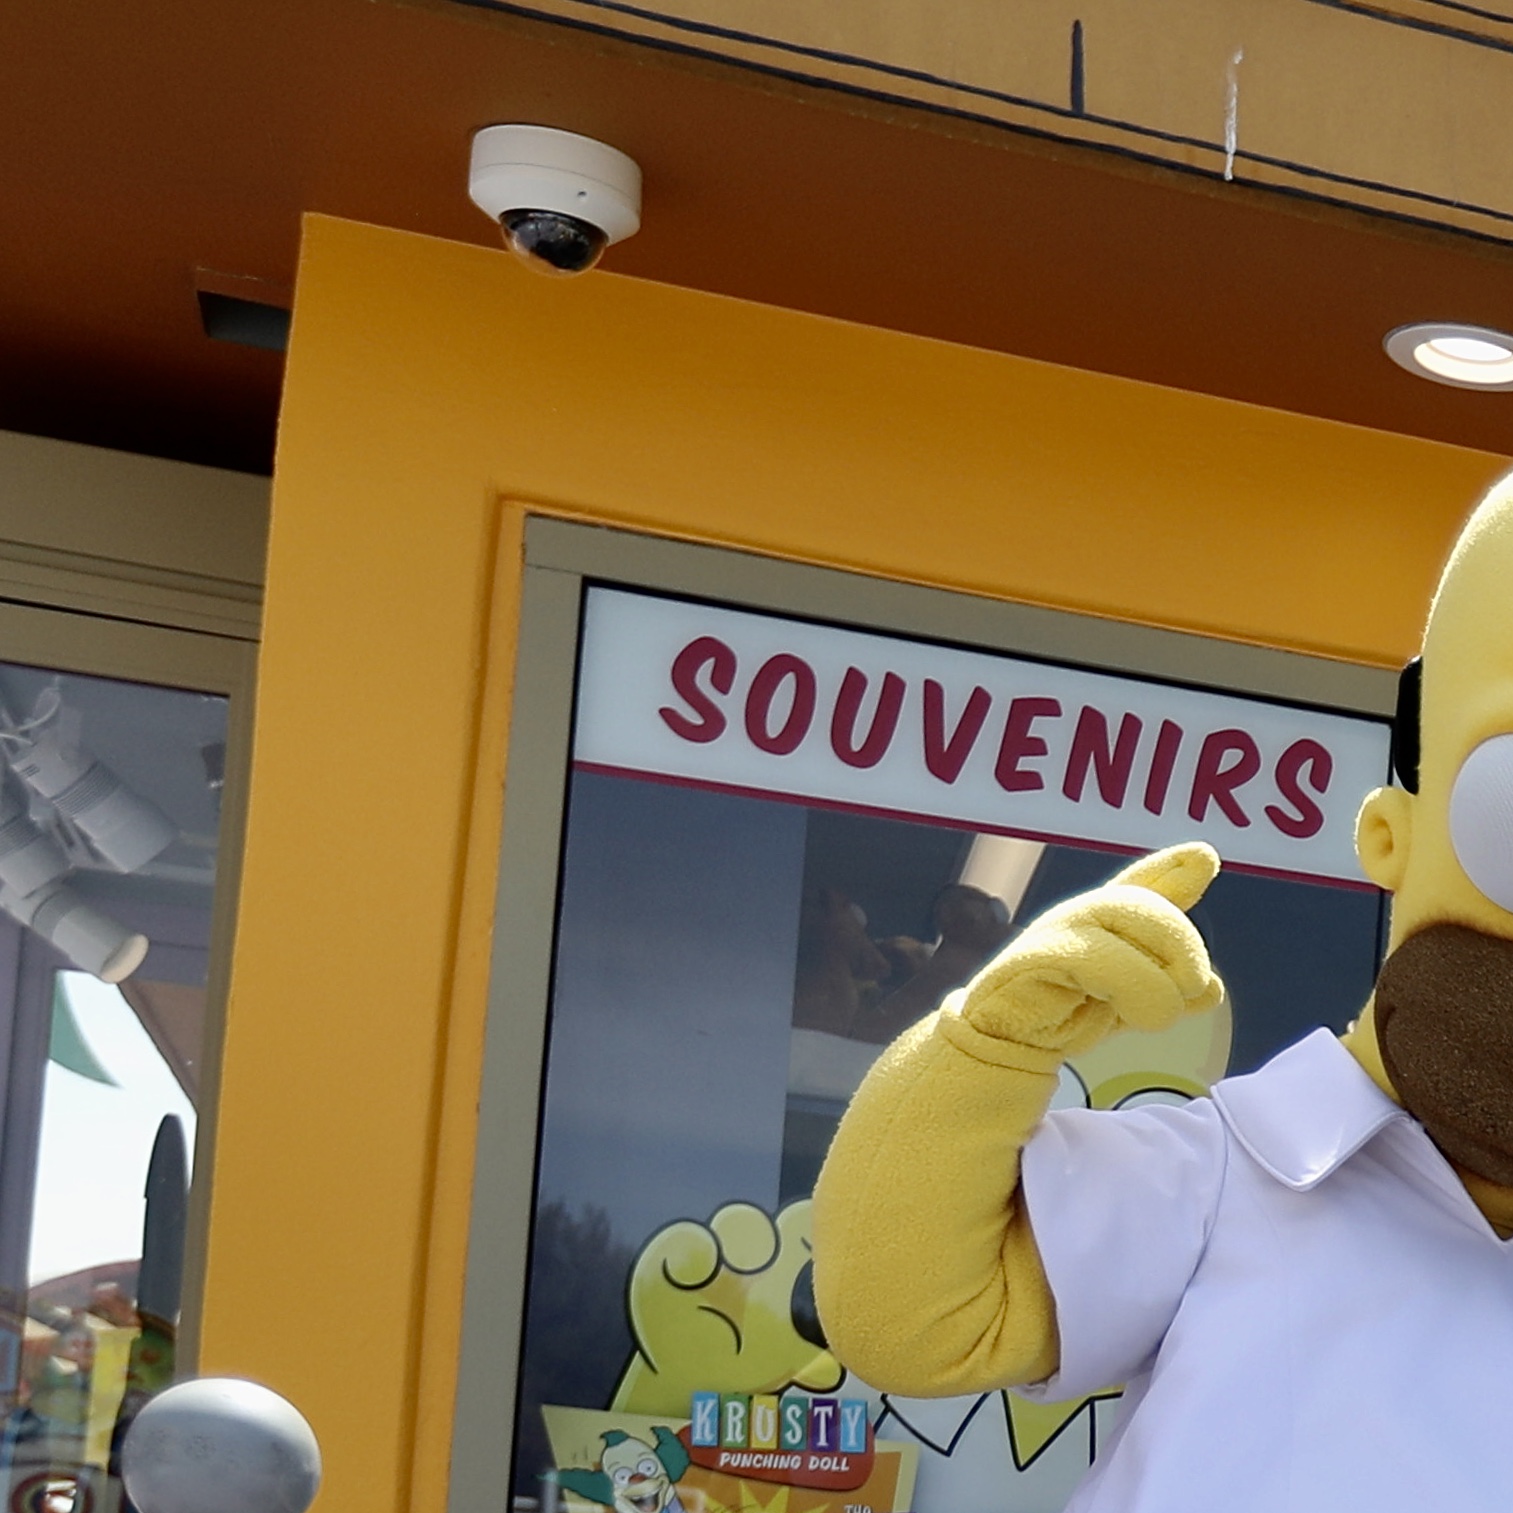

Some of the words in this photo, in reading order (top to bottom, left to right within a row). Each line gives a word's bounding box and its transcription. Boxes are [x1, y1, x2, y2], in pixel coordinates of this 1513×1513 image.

[657, 636, 1334, 839] SOUVENIRS
[694, 1398, 864, 1449] KRUSTY
[719, 1452, 801, 1470] PUNCHING
[808, 1456, 850, 1471] DOLL
